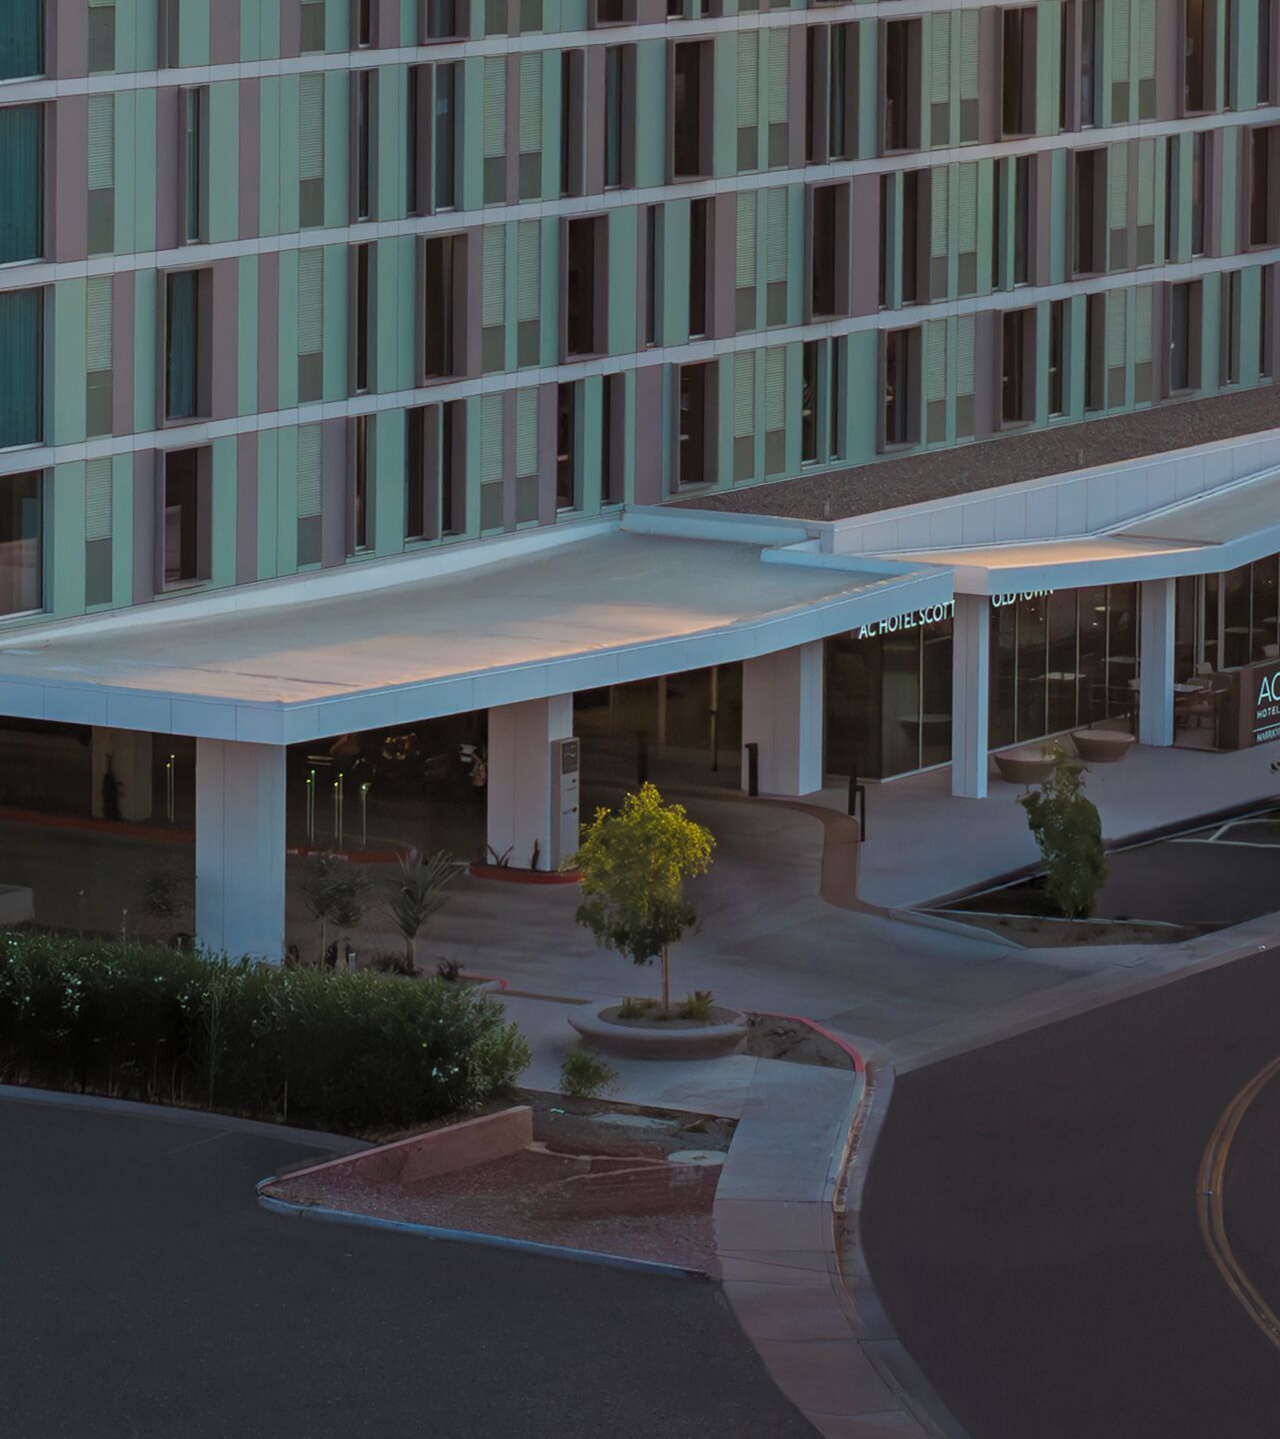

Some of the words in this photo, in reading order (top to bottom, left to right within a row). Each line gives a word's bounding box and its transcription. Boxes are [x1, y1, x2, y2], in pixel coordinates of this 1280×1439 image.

[858, 624, 876, 639] AC
[879, 612, 916, 634] HOTEL
[991, 592, 1017, 608] OLD
